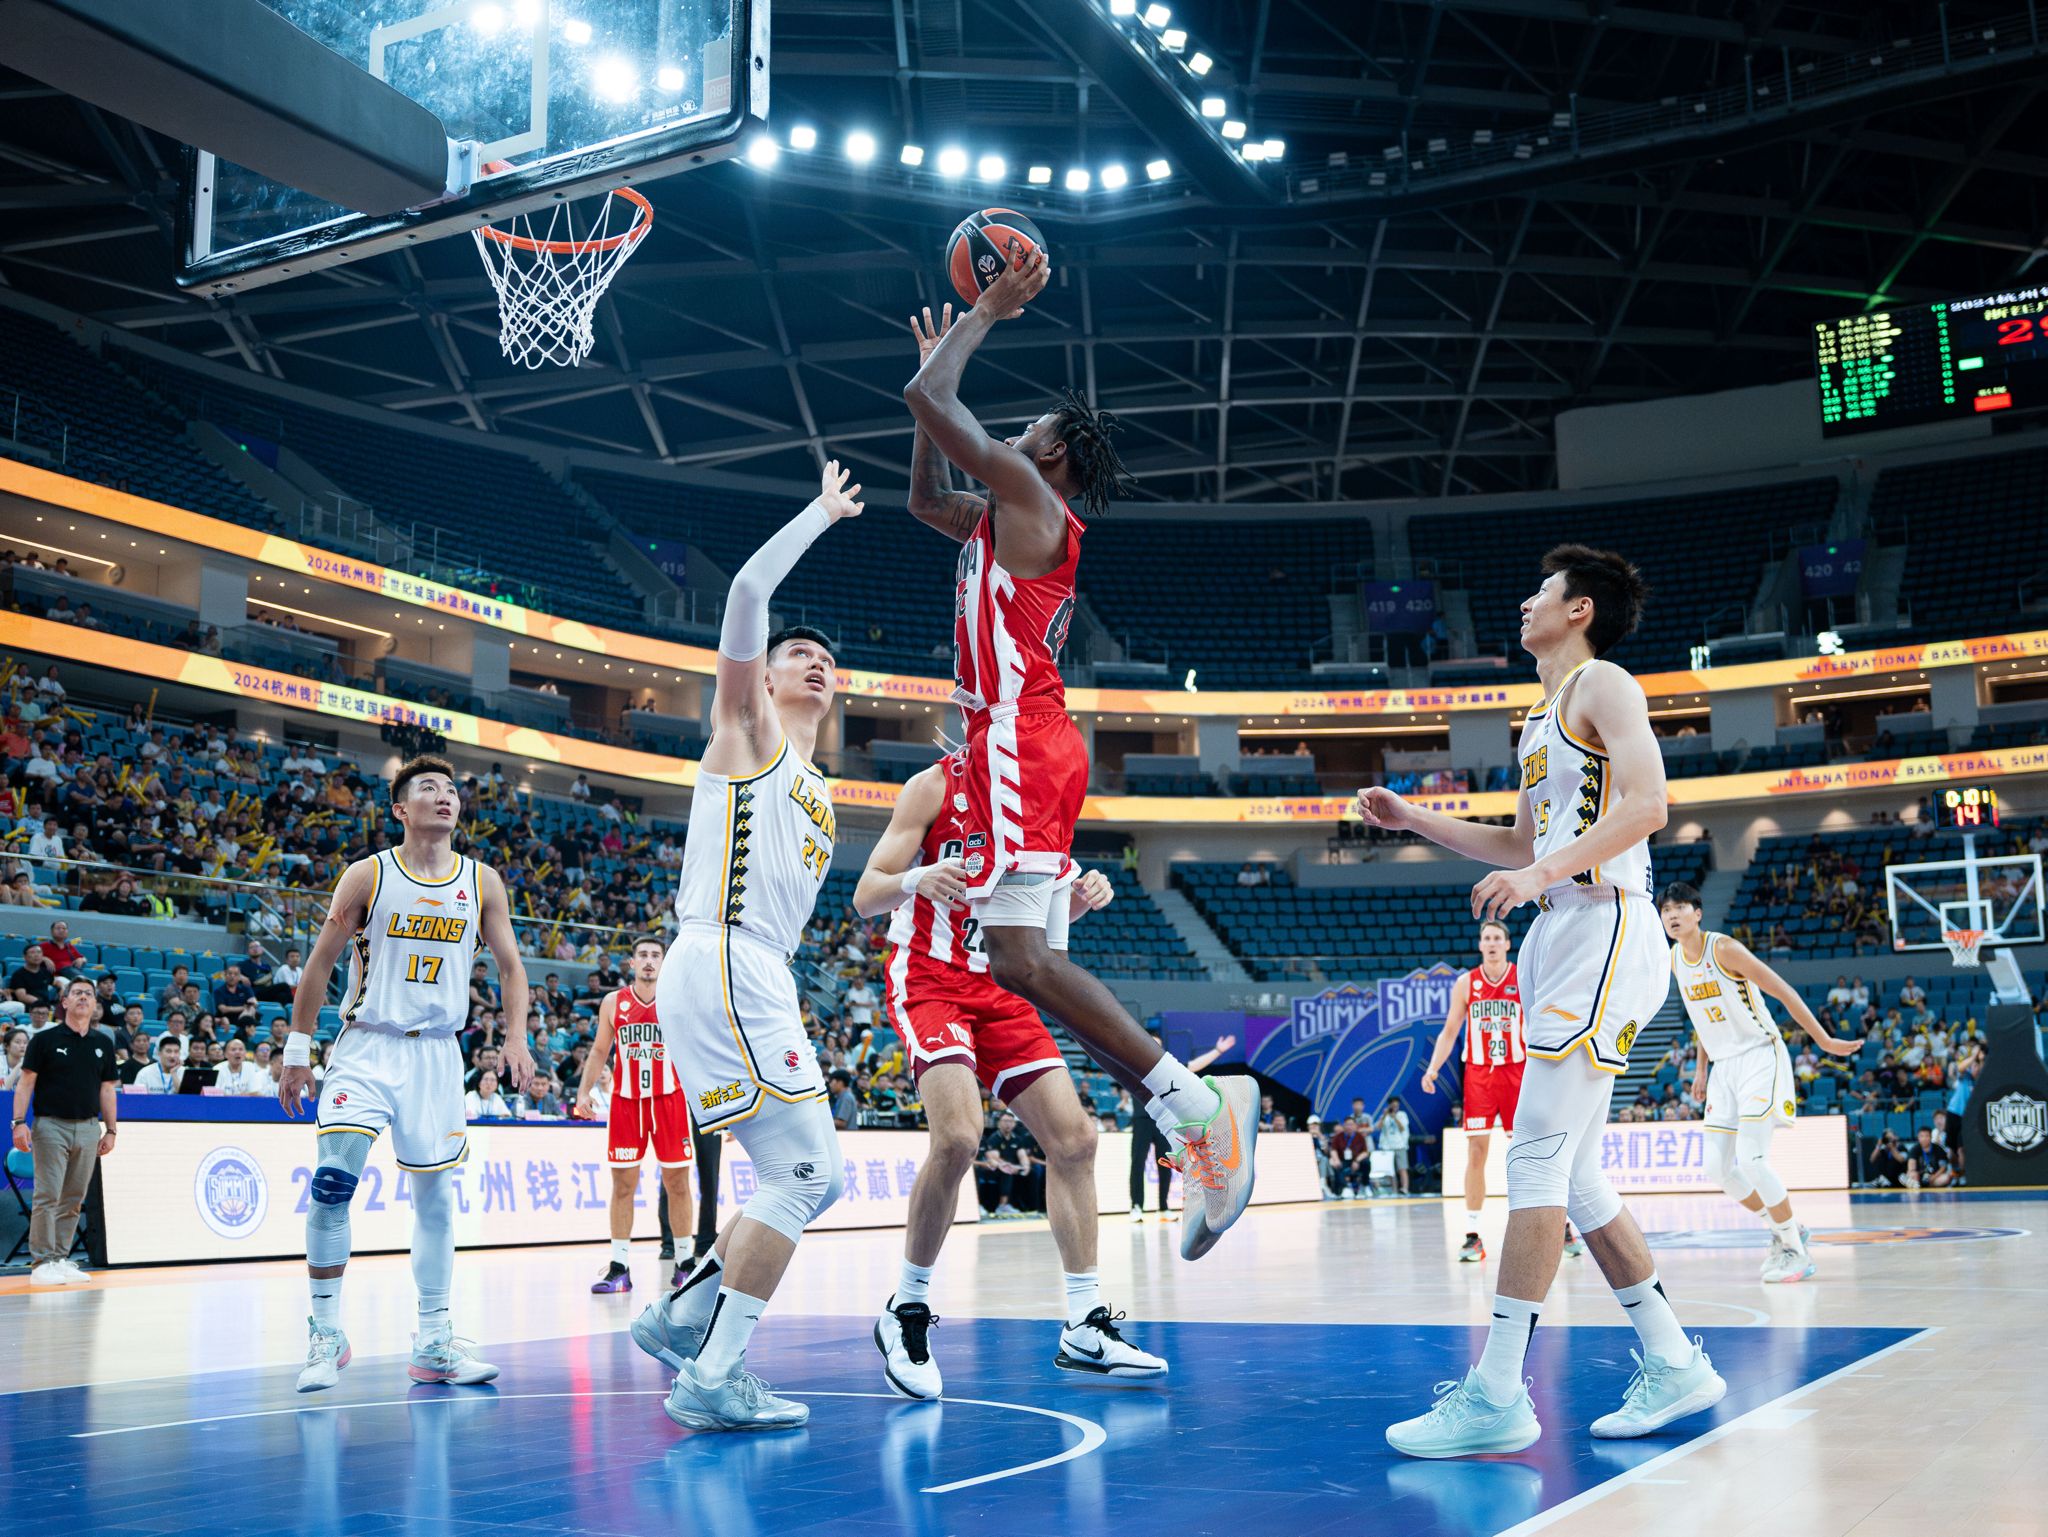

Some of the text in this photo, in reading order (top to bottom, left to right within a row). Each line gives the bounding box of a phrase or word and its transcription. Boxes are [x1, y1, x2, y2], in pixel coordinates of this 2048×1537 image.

[1843, 560, 1862, 574] 42
[1807, 651, 1924, 675] INTERNATIONAL
[1932, 641, 2027, 661] BASKETBALL
[866, 680, 948, 696] BASKETBALL
[1777, 768, 1899, 788] INTERNATIONAL
[1906, 757, 2004, 776] BASKETBALL
[833, 786, 897, 801] SKETBALL
[789, 774, 836, 849] LION
[1957, 805, 1981, 827] 14
[802, 833, 830, 882] 24
[387, 912, 468, 943] LIONS
[405, 954, 444, 985] 17
[1387, 983, 1454, 1026] SUM
[1472, 1000, 1517, 1019] GIRONA
[1704, 1006, 1727, 1023] 12
[619, 1023, 665, 1046] GIRON
[1488, 1040, 1507, 1057] 29
[641, 1070, 651, 1089] 9
[699, 1080, 746, 1110] 浙江
[1990, 1104, 2044, 1132] SUMMIT
